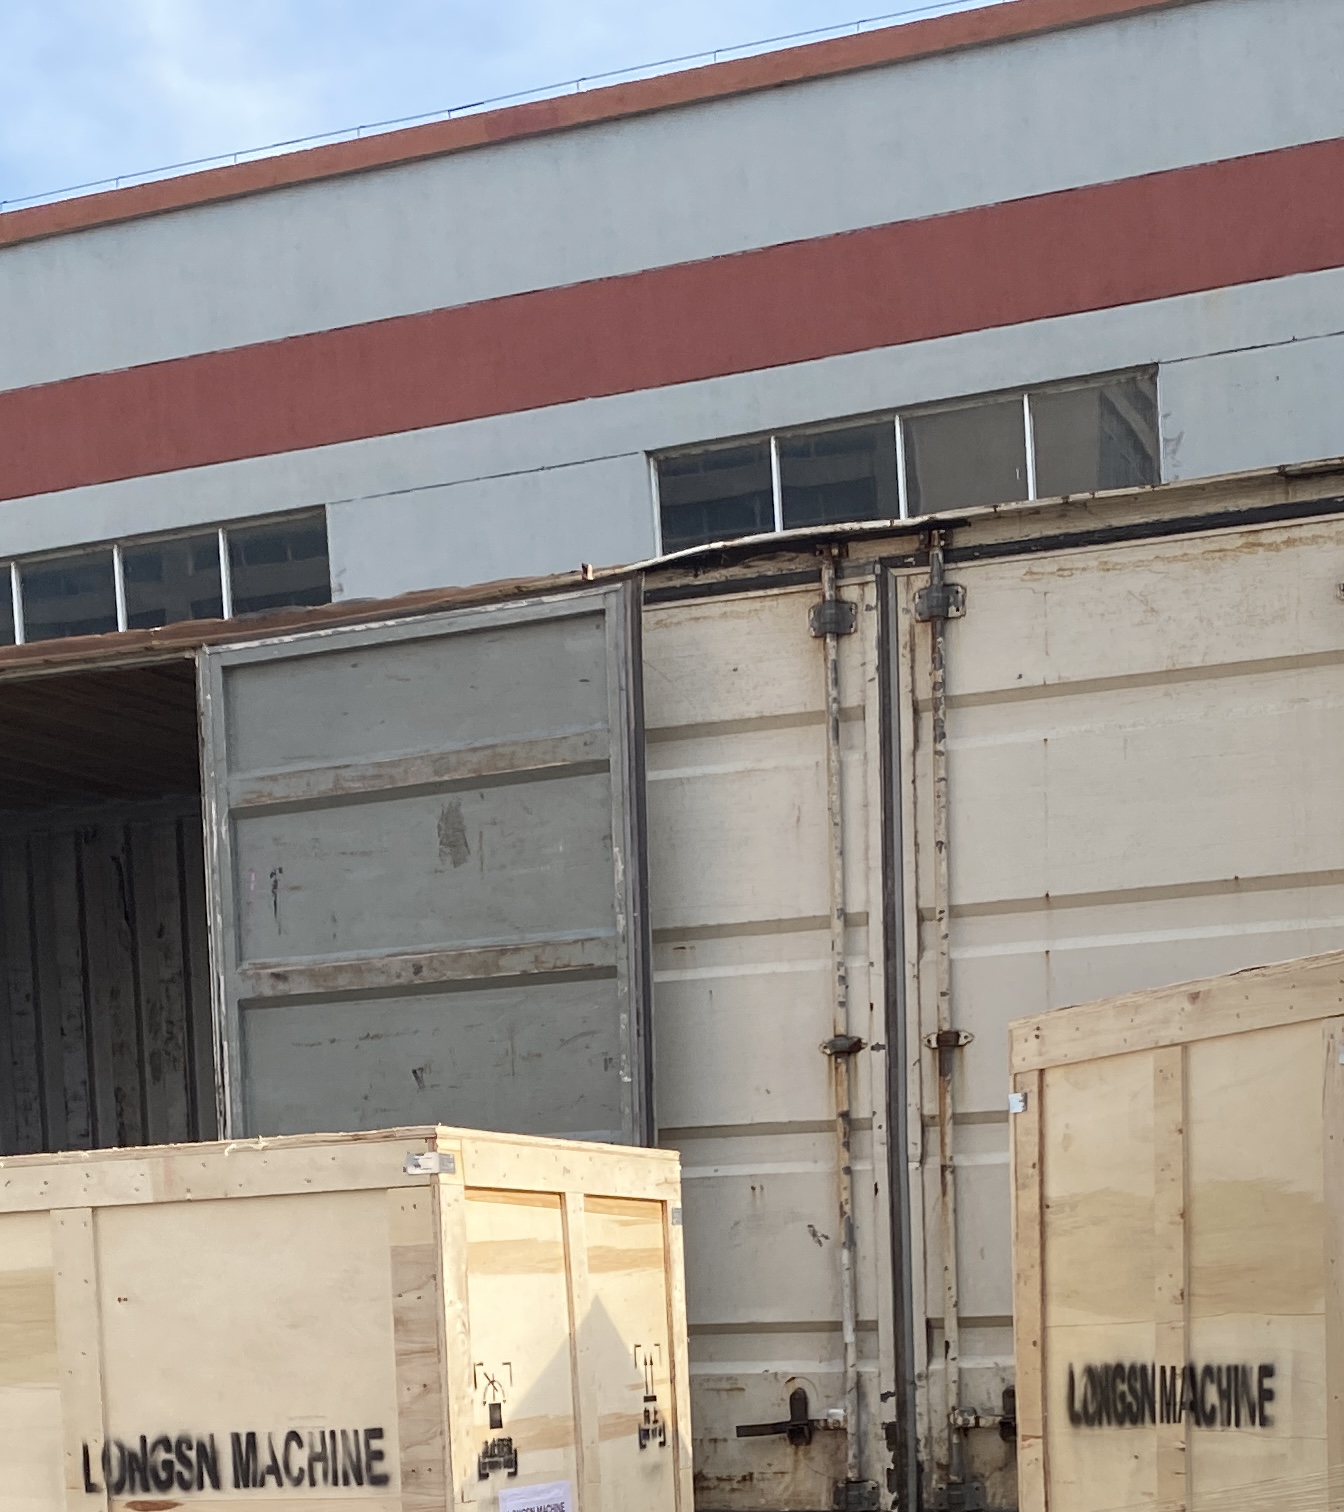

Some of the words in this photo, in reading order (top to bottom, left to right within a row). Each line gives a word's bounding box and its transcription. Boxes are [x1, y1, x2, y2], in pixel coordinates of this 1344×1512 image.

[1067, 1361, 1156, 1428] LONGSN
[1158, 1361, 1276, 1428] MACHINE
[81, 1432, 221, 1496] LONGSN
[230, 1427, 391, 1489] MACHINE
